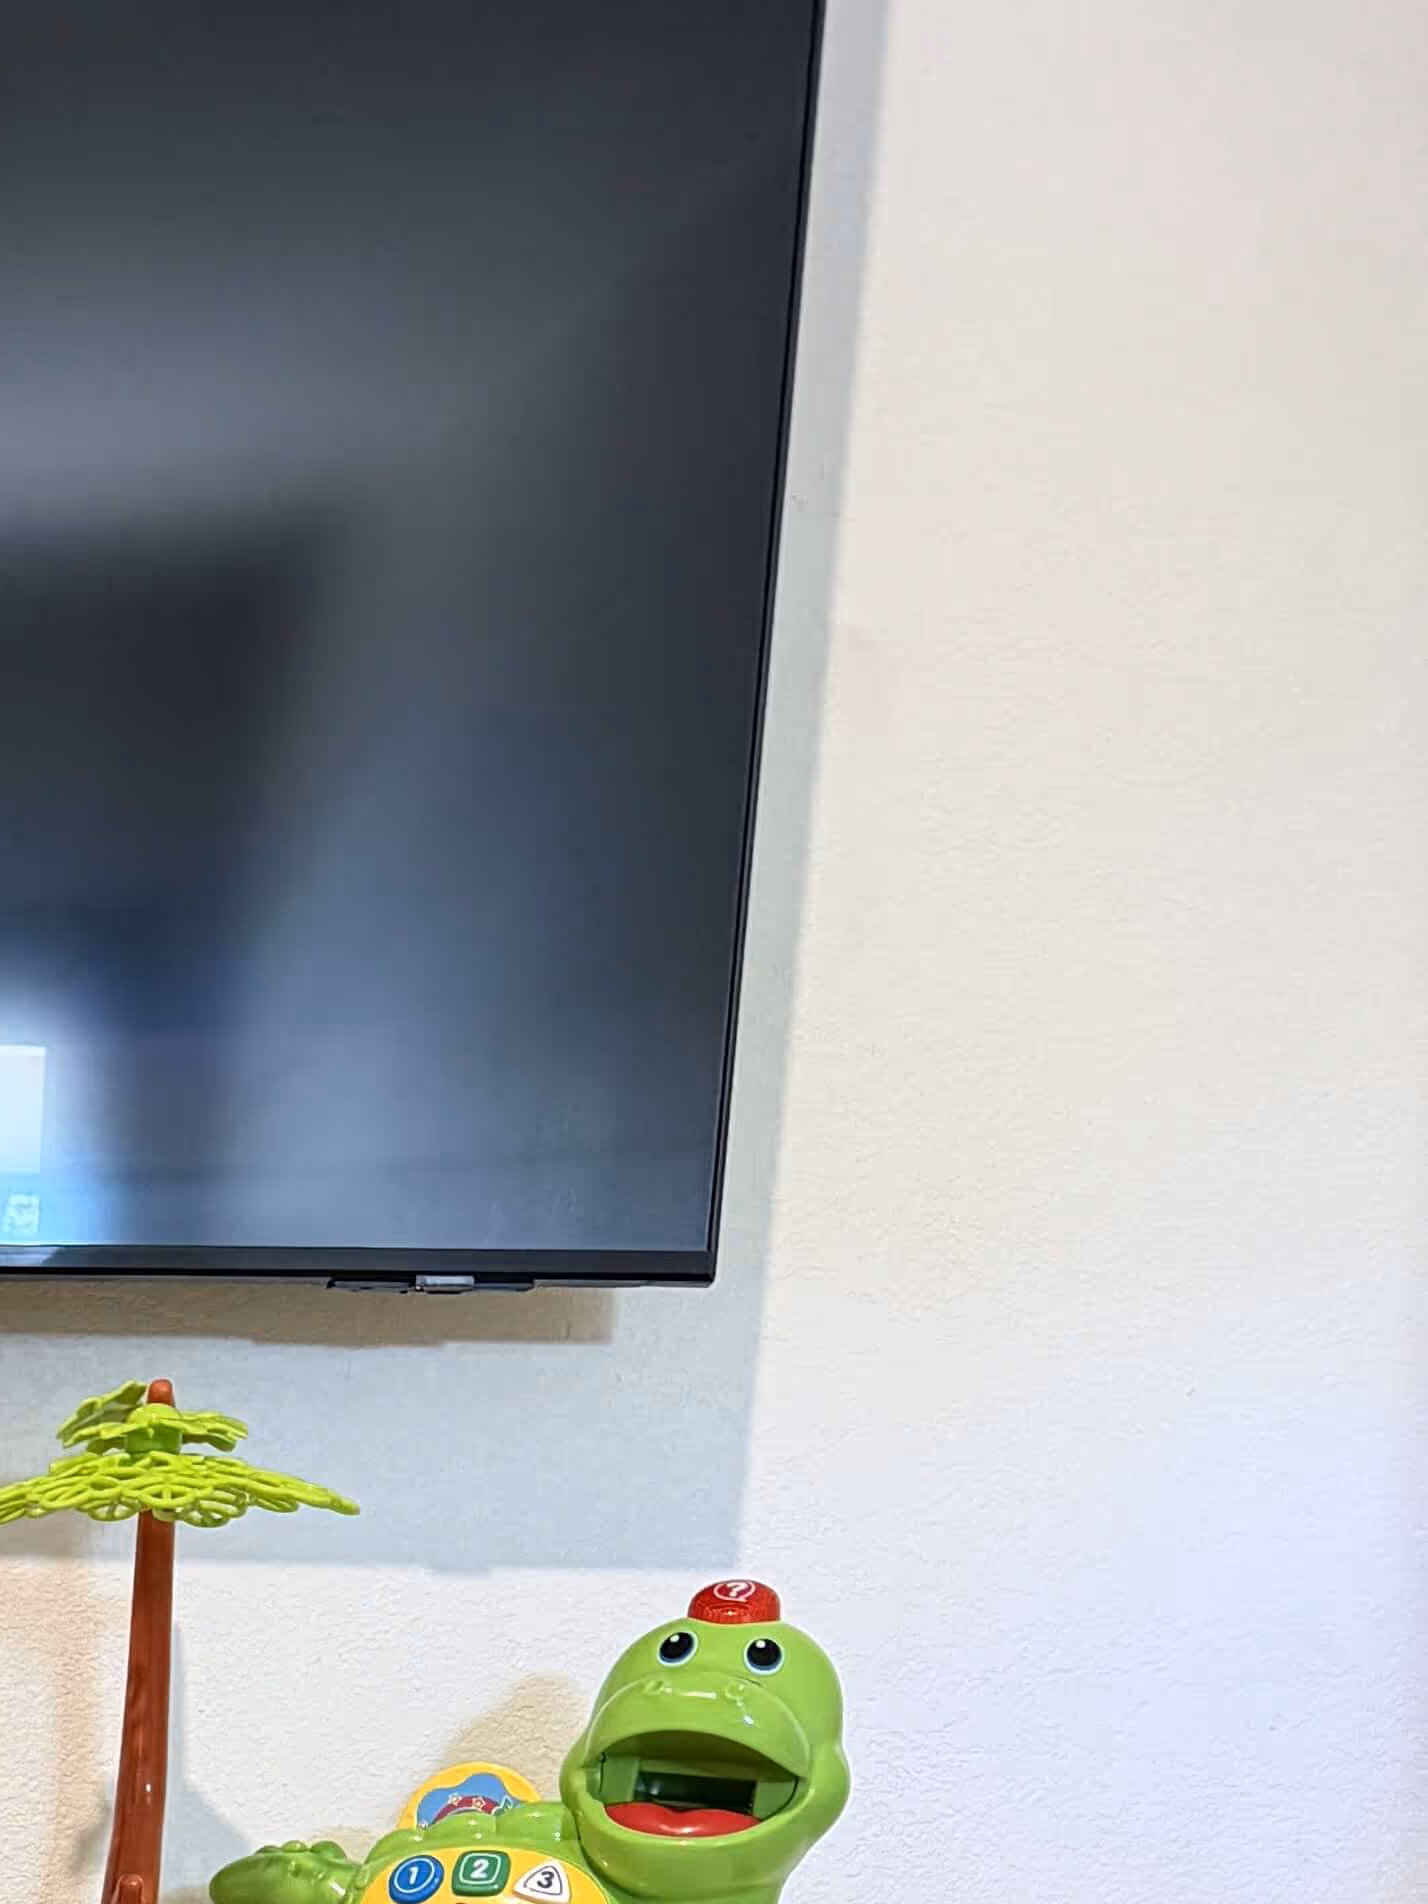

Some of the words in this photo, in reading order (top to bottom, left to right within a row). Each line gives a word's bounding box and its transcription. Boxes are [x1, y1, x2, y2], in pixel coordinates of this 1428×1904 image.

[408, 1867, 419, 1885] 1
[470, 1858, 489, 1879] 2
[536, 1871, 555, 1890] 3
